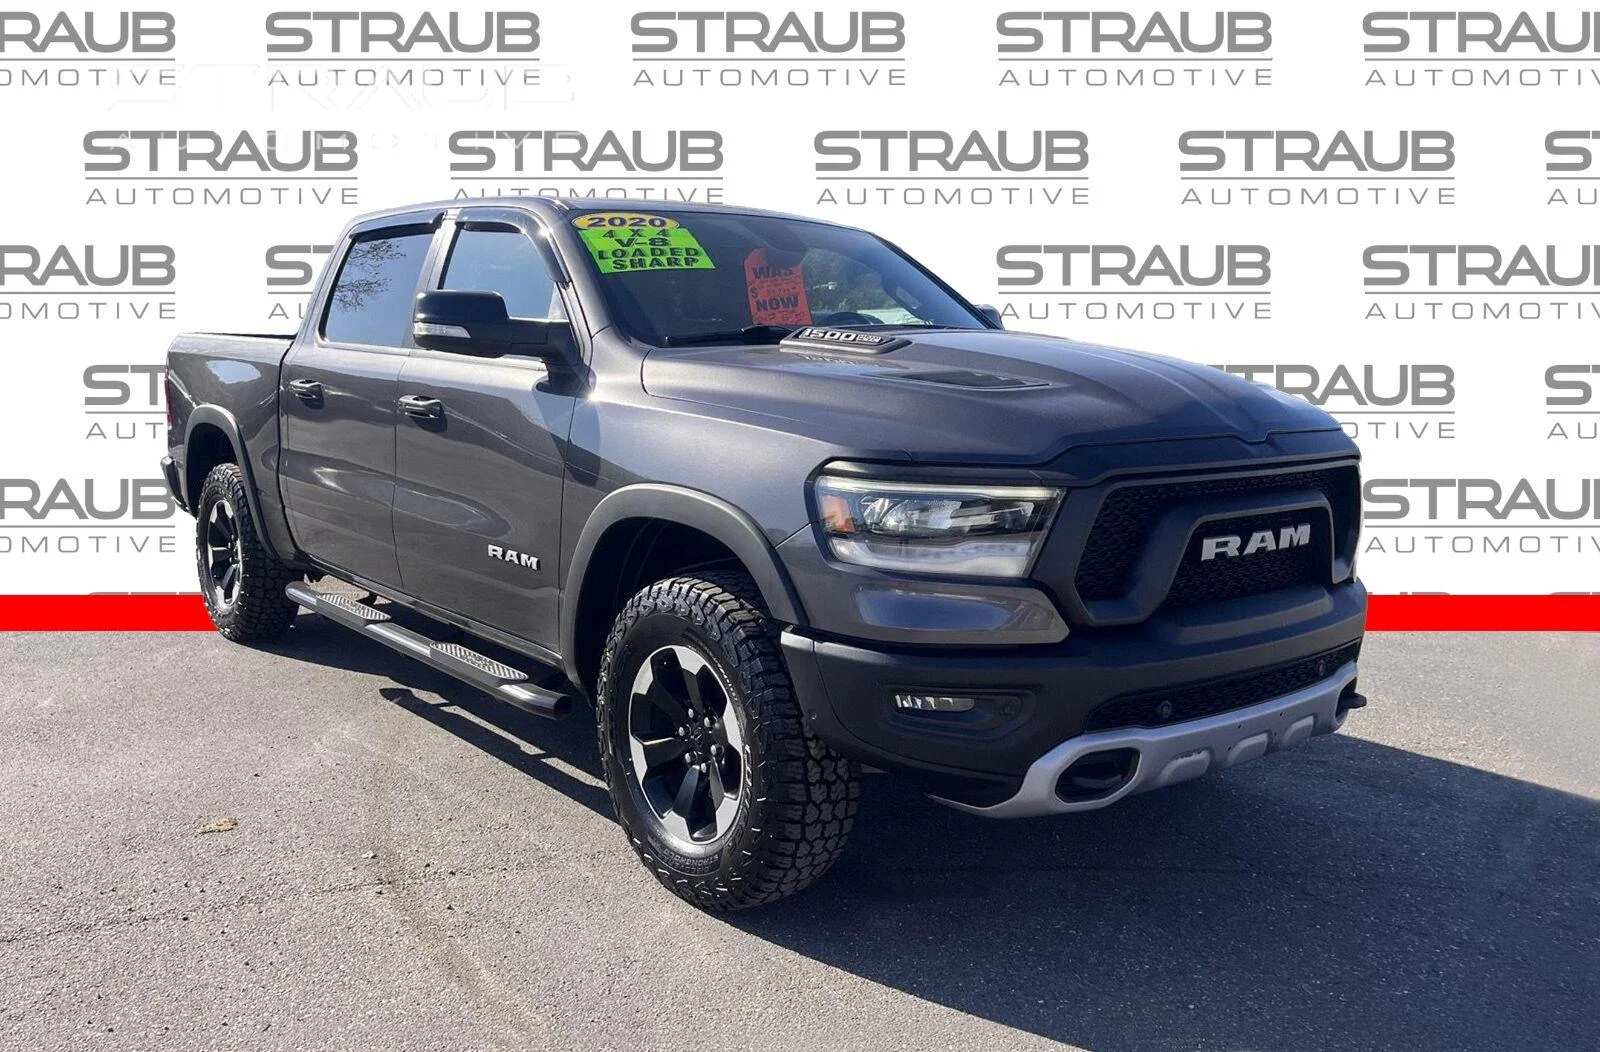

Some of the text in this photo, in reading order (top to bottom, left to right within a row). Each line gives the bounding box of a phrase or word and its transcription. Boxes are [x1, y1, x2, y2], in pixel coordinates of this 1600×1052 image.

[588, 217, 666, 228] 2020
[603, 230, 617, 239] 4
[657, 229, 670, 238] 4
[615, 238, 670, 248] V-8
[598, 248, 700, 260] LOADED
[613, 257, 699, 270] SHARP
[756, 295, 799, 312] NOW
[799, 328, 858, 342] 1500
[1201, 523, 1311, 561] RAM
[487, 544, 539, 571] RAM
